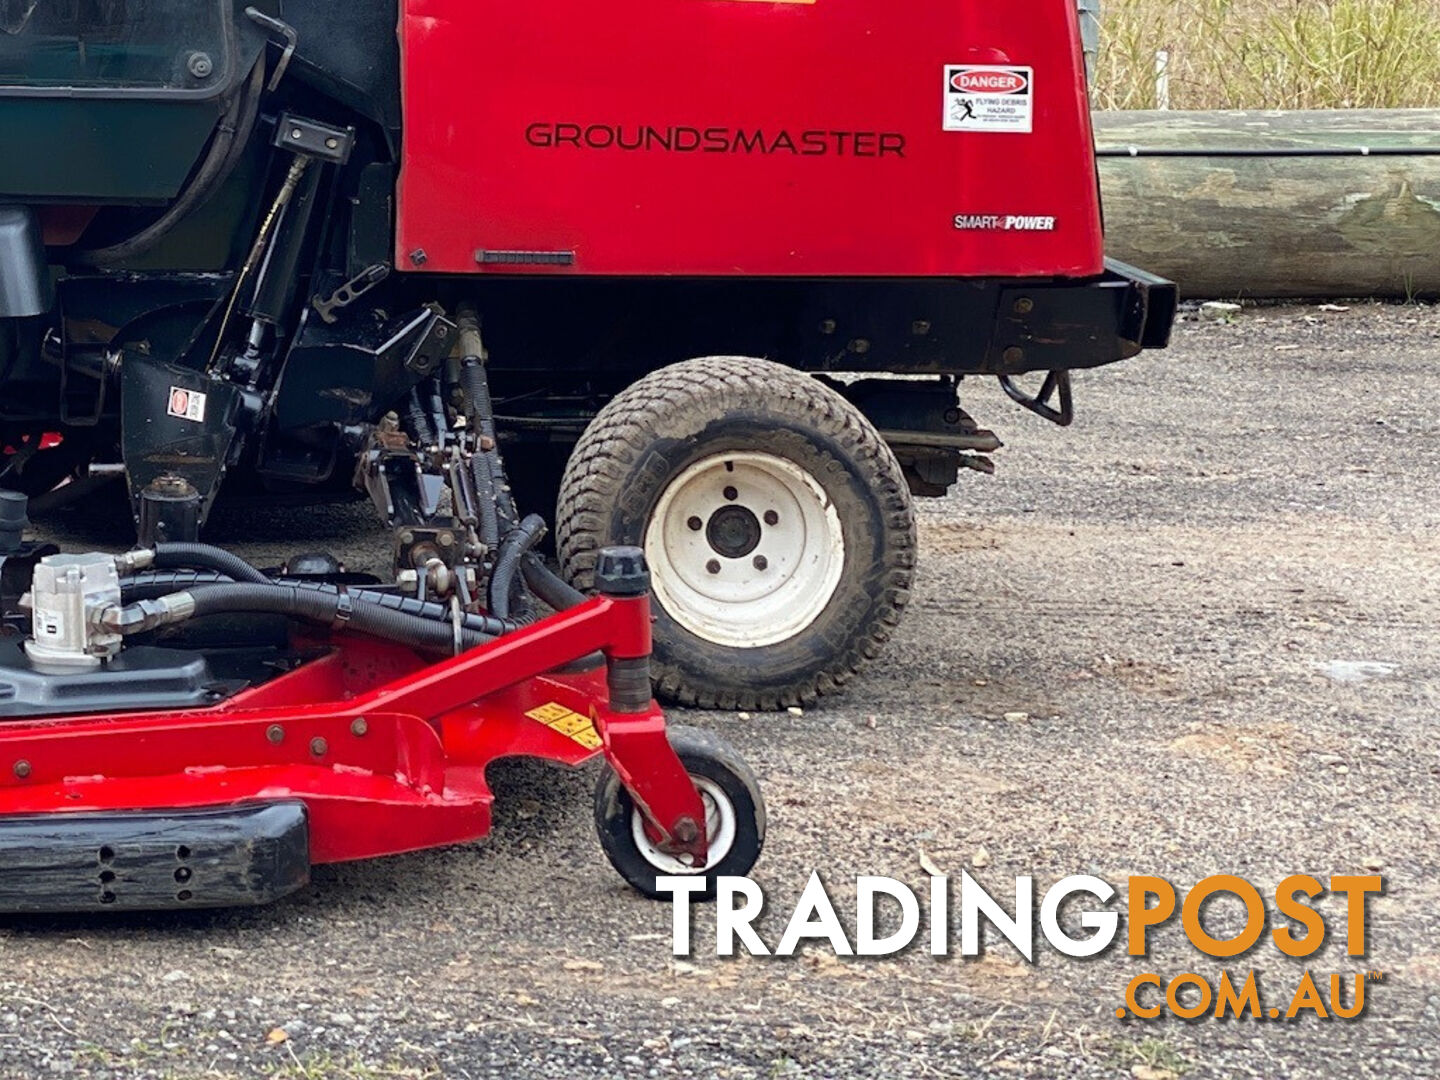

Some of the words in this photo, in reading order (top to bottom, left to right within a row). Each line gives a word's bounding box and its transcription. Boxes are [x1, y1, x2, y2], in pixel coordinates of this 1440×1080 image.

[960, 76, 1017, 88] DANGER
[525, 123, 907, 158] GROUNDSMASTER
[954, 215, 998, 229] SMART
[1004, 215, 1054, 230] POWER
